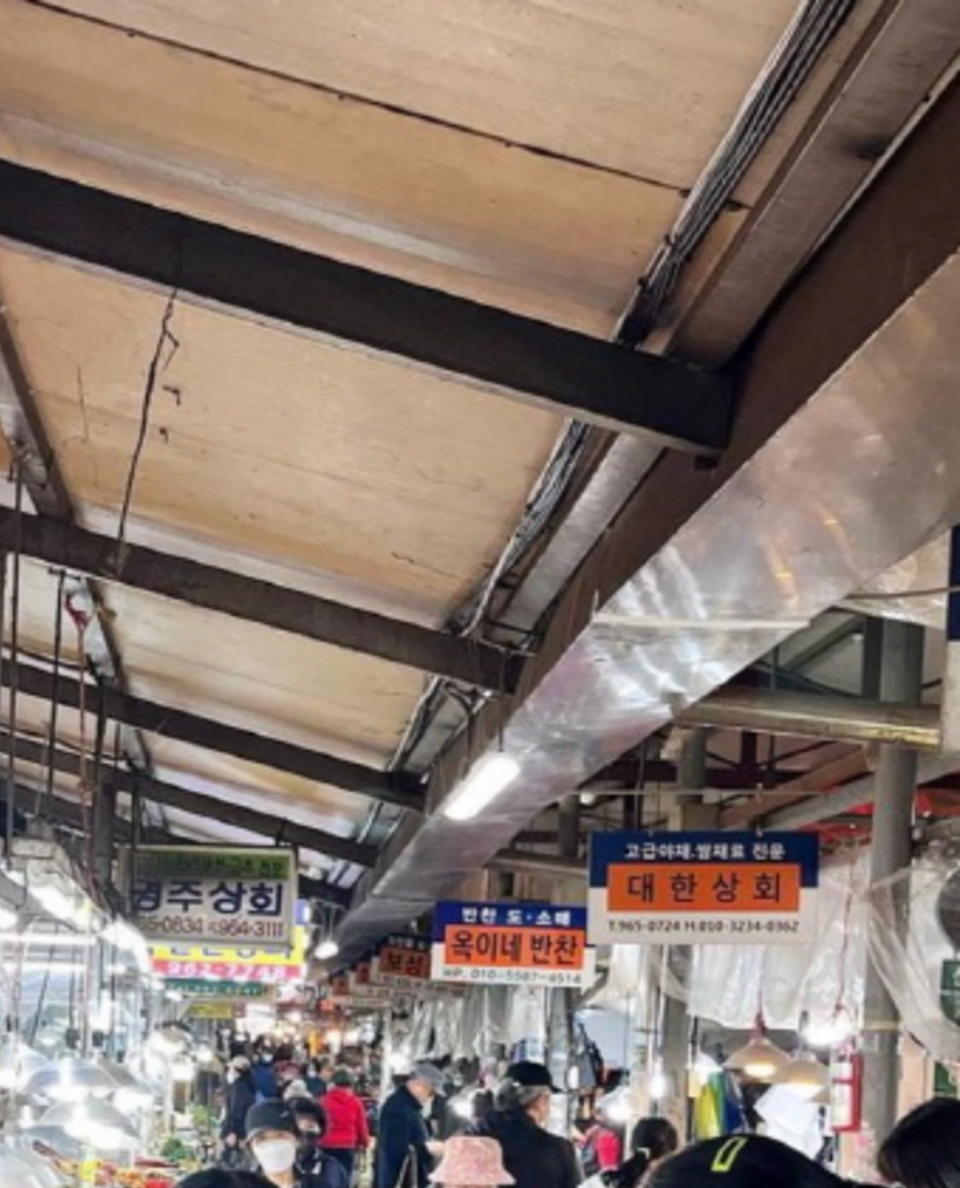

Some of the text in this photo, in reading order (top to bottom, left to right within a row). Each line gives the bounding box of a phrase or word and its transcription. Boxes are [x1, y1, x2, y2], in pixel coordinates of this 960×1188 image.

[627, 872, 781, 903] 대한상회
[451, 929, 522, 963] 옥이네
[530, 933, 577, 965] 반찬
